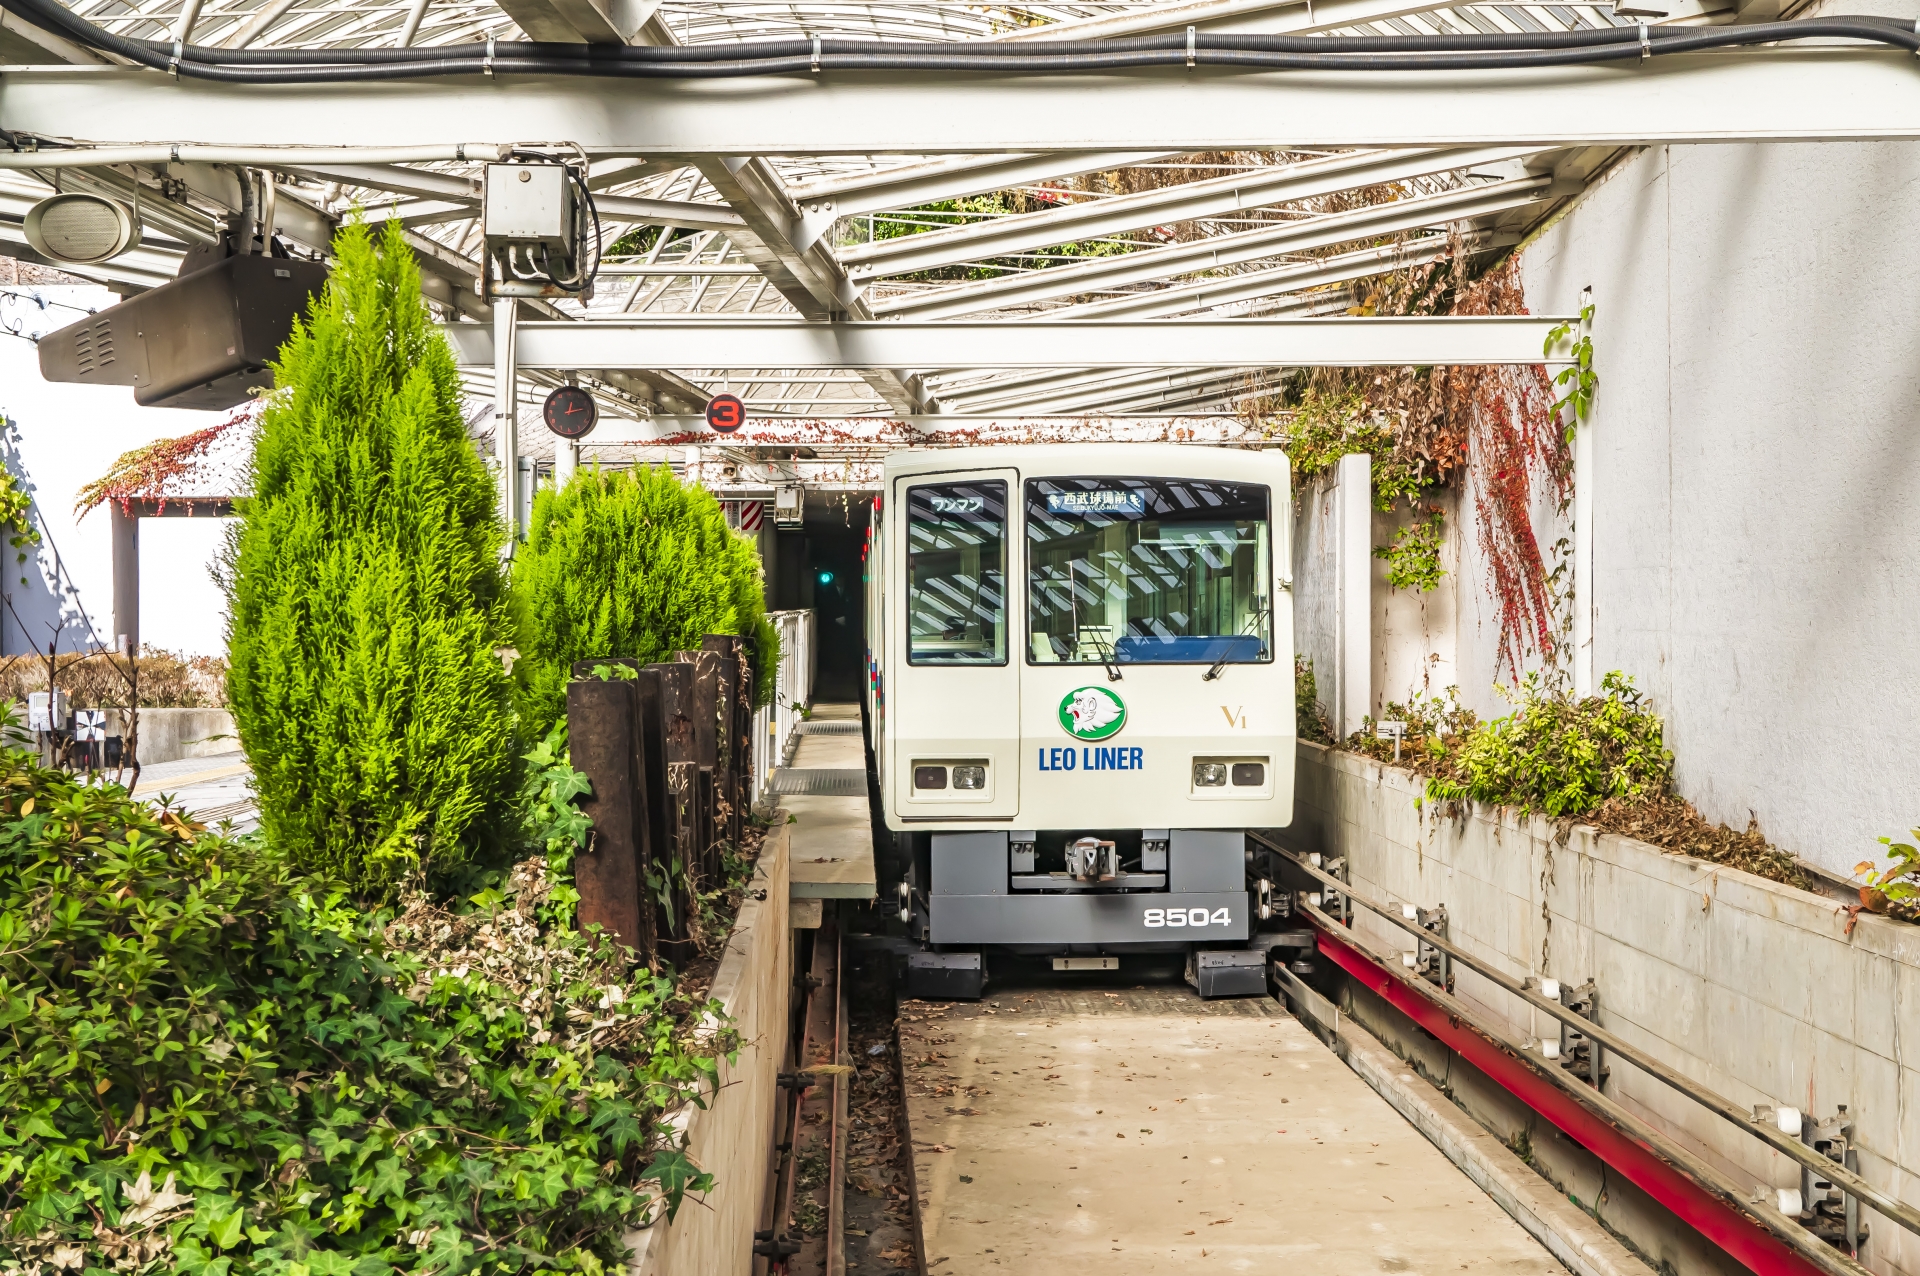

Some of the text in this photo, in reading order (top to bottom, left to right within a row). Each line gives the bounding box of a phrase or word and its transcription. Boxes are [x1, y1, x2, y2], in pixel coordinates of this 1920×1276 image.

[711, 401, 740, 427] 3
[931, 499, 981, 512] ワンマン
[1064, 492, 1127, 505] 西武球場前
[1039, 747, 1144, 771] LEO LINER
[1143, 907, 1232, 928] 8504
